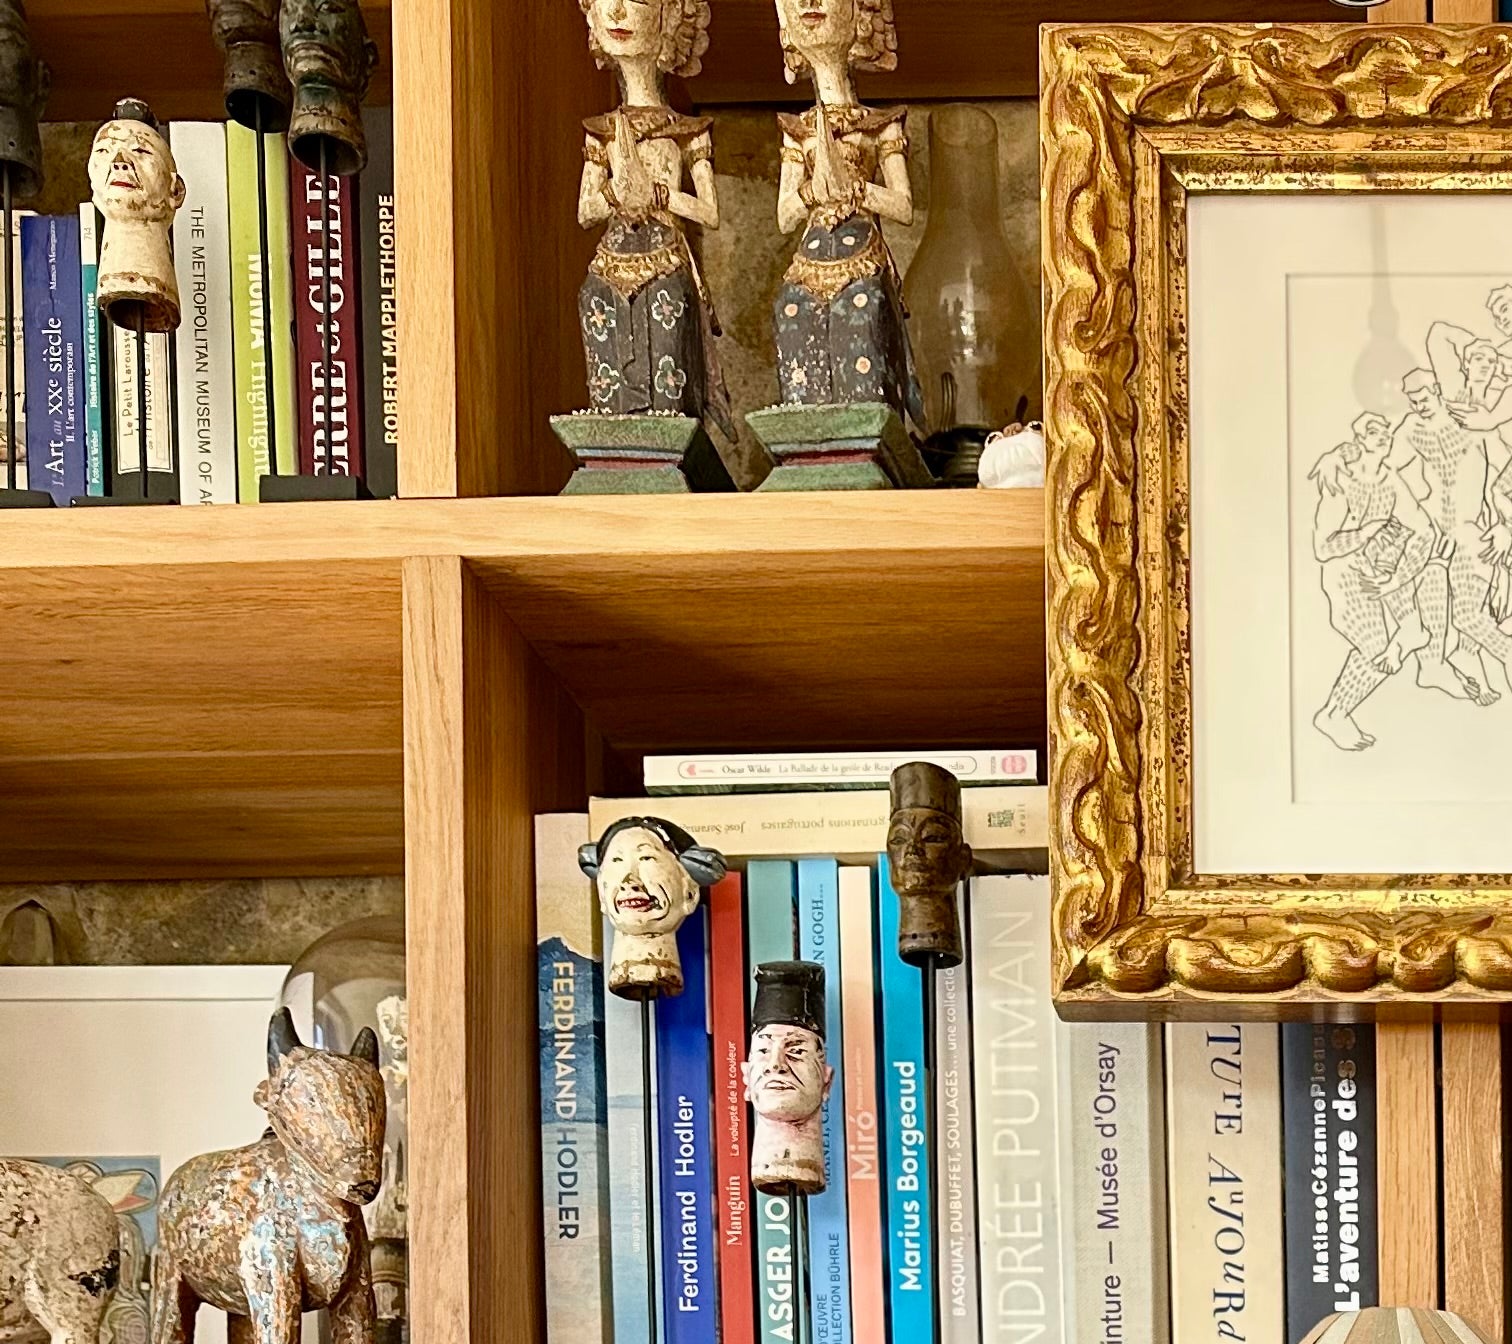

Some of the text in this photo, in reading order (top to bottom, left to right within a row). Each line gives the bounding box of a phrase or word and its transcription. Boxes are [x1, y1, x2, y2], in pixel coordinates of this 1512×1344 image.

[189, 206, 203, 239] THE
[191, 246, 209, 374] METROPOLITAN
[378, 194, 399, 445] ROBERT MAPPLETHORPE
[195, 376, 212, 455] MUSEUM
[198, 454, 214, 485] OF
[983, 905, 1043, 1163] PUTMAN
[1092, 1040, 1122, 1140] d'Orsay
[551, 961, 580, 1241] FERDINAND HODLER
[850, 1109, 878, 1182] Miró
[674, 1094, 700, 1314] Ferdinand Hodler
[895, 1059, 928, 1292] Marius Borgeaud
[1095, 1144, 1121, 1231] Musée
[1332, 1129, 1363, 1314] L'aventure
[767, 1237, 796, 1344] ASGER
